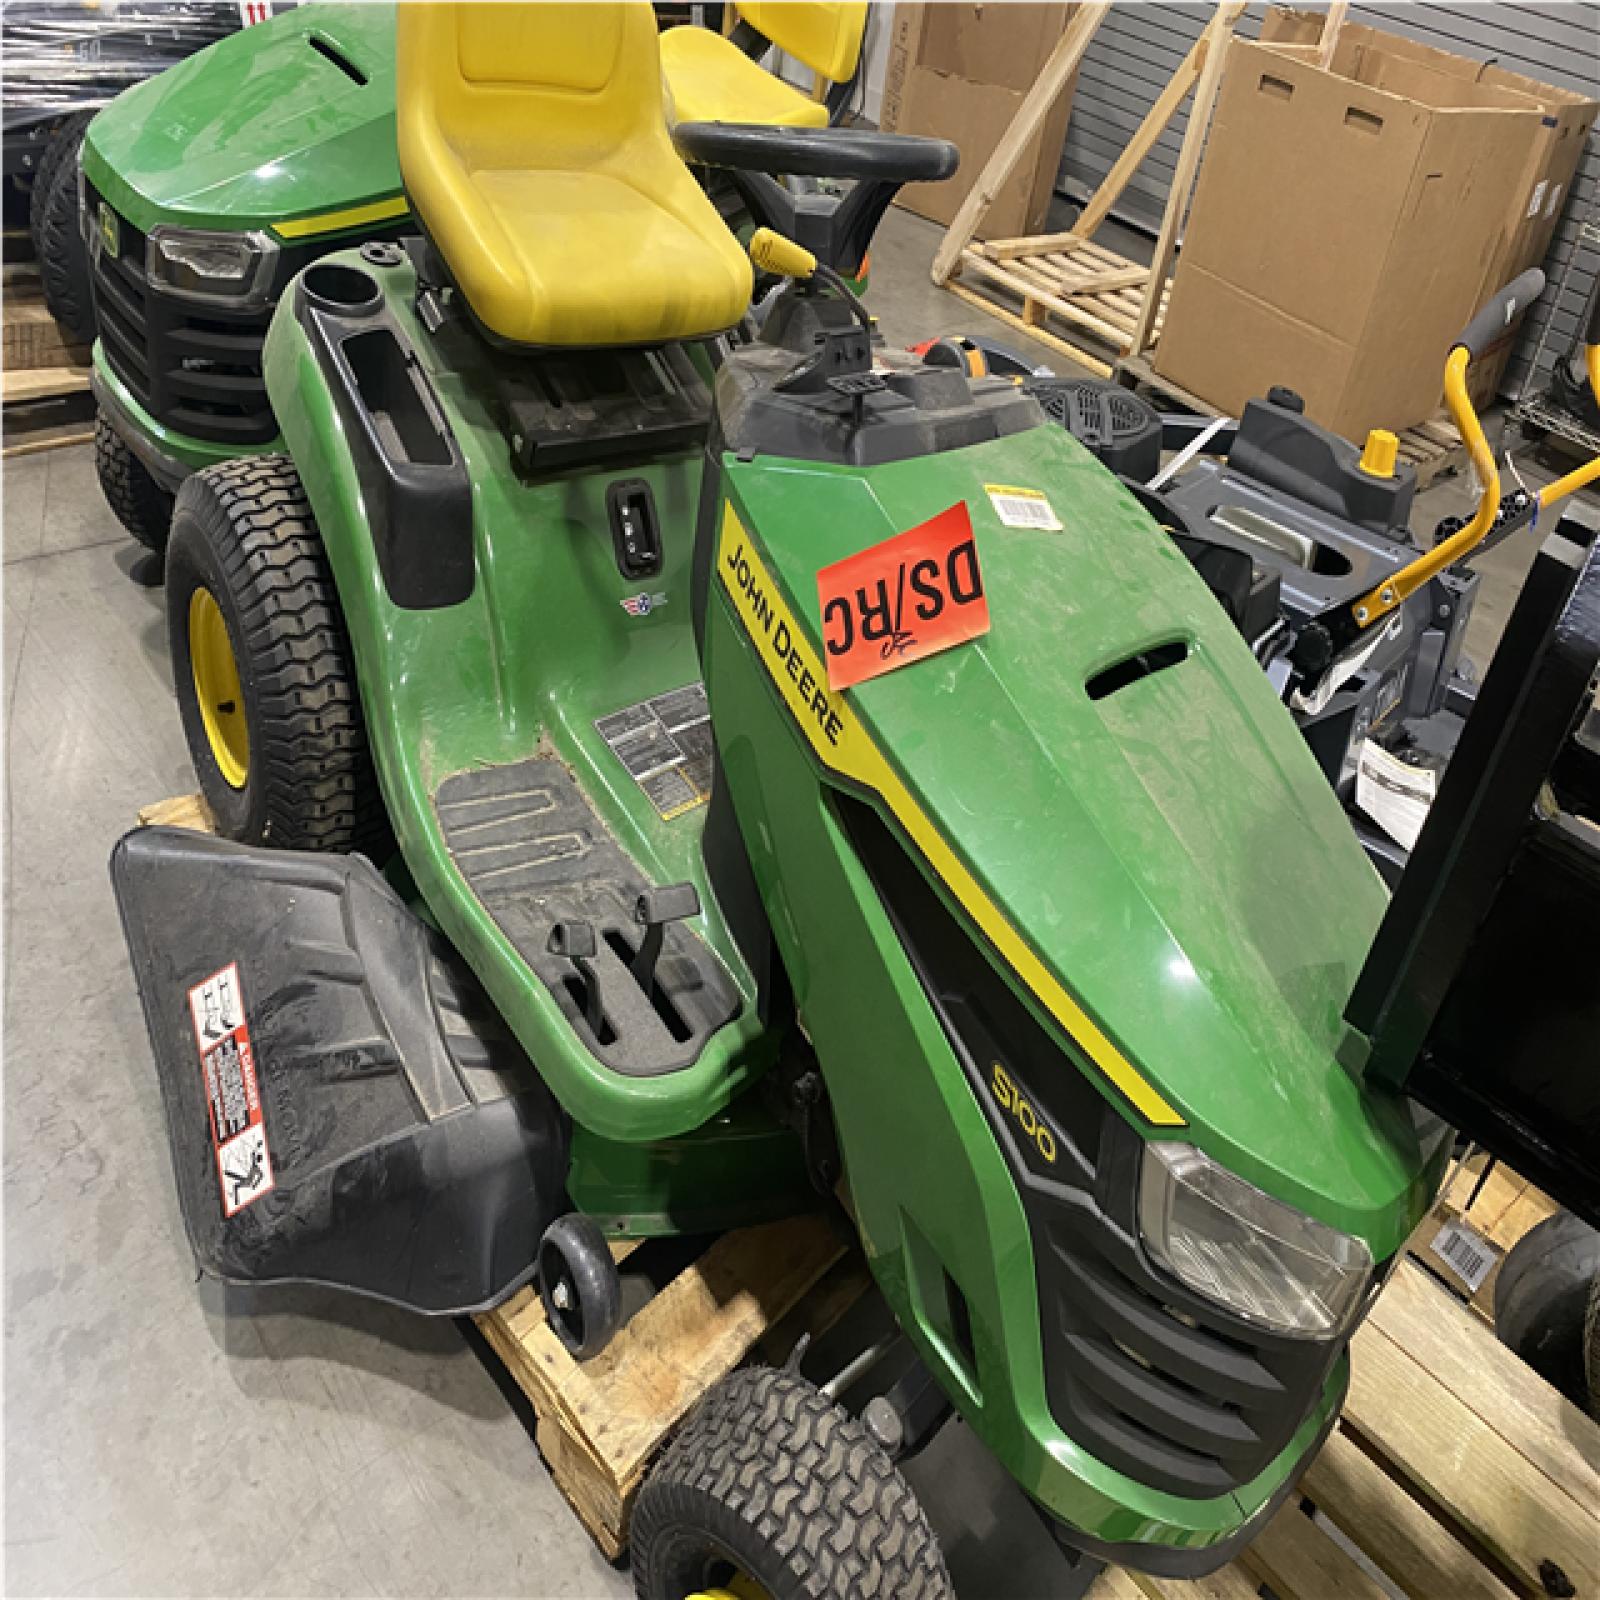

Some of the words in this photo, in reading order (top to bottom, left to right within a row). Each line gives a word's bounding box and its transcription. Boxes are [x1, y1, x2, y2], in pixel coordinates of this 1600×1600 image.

[728, 545, 774, 633] JOHN
[773, 620, 843, 745] DEERE
[824, 539, 983, 656] DS/RC
[992, 1064, 1056, 1163] S100
